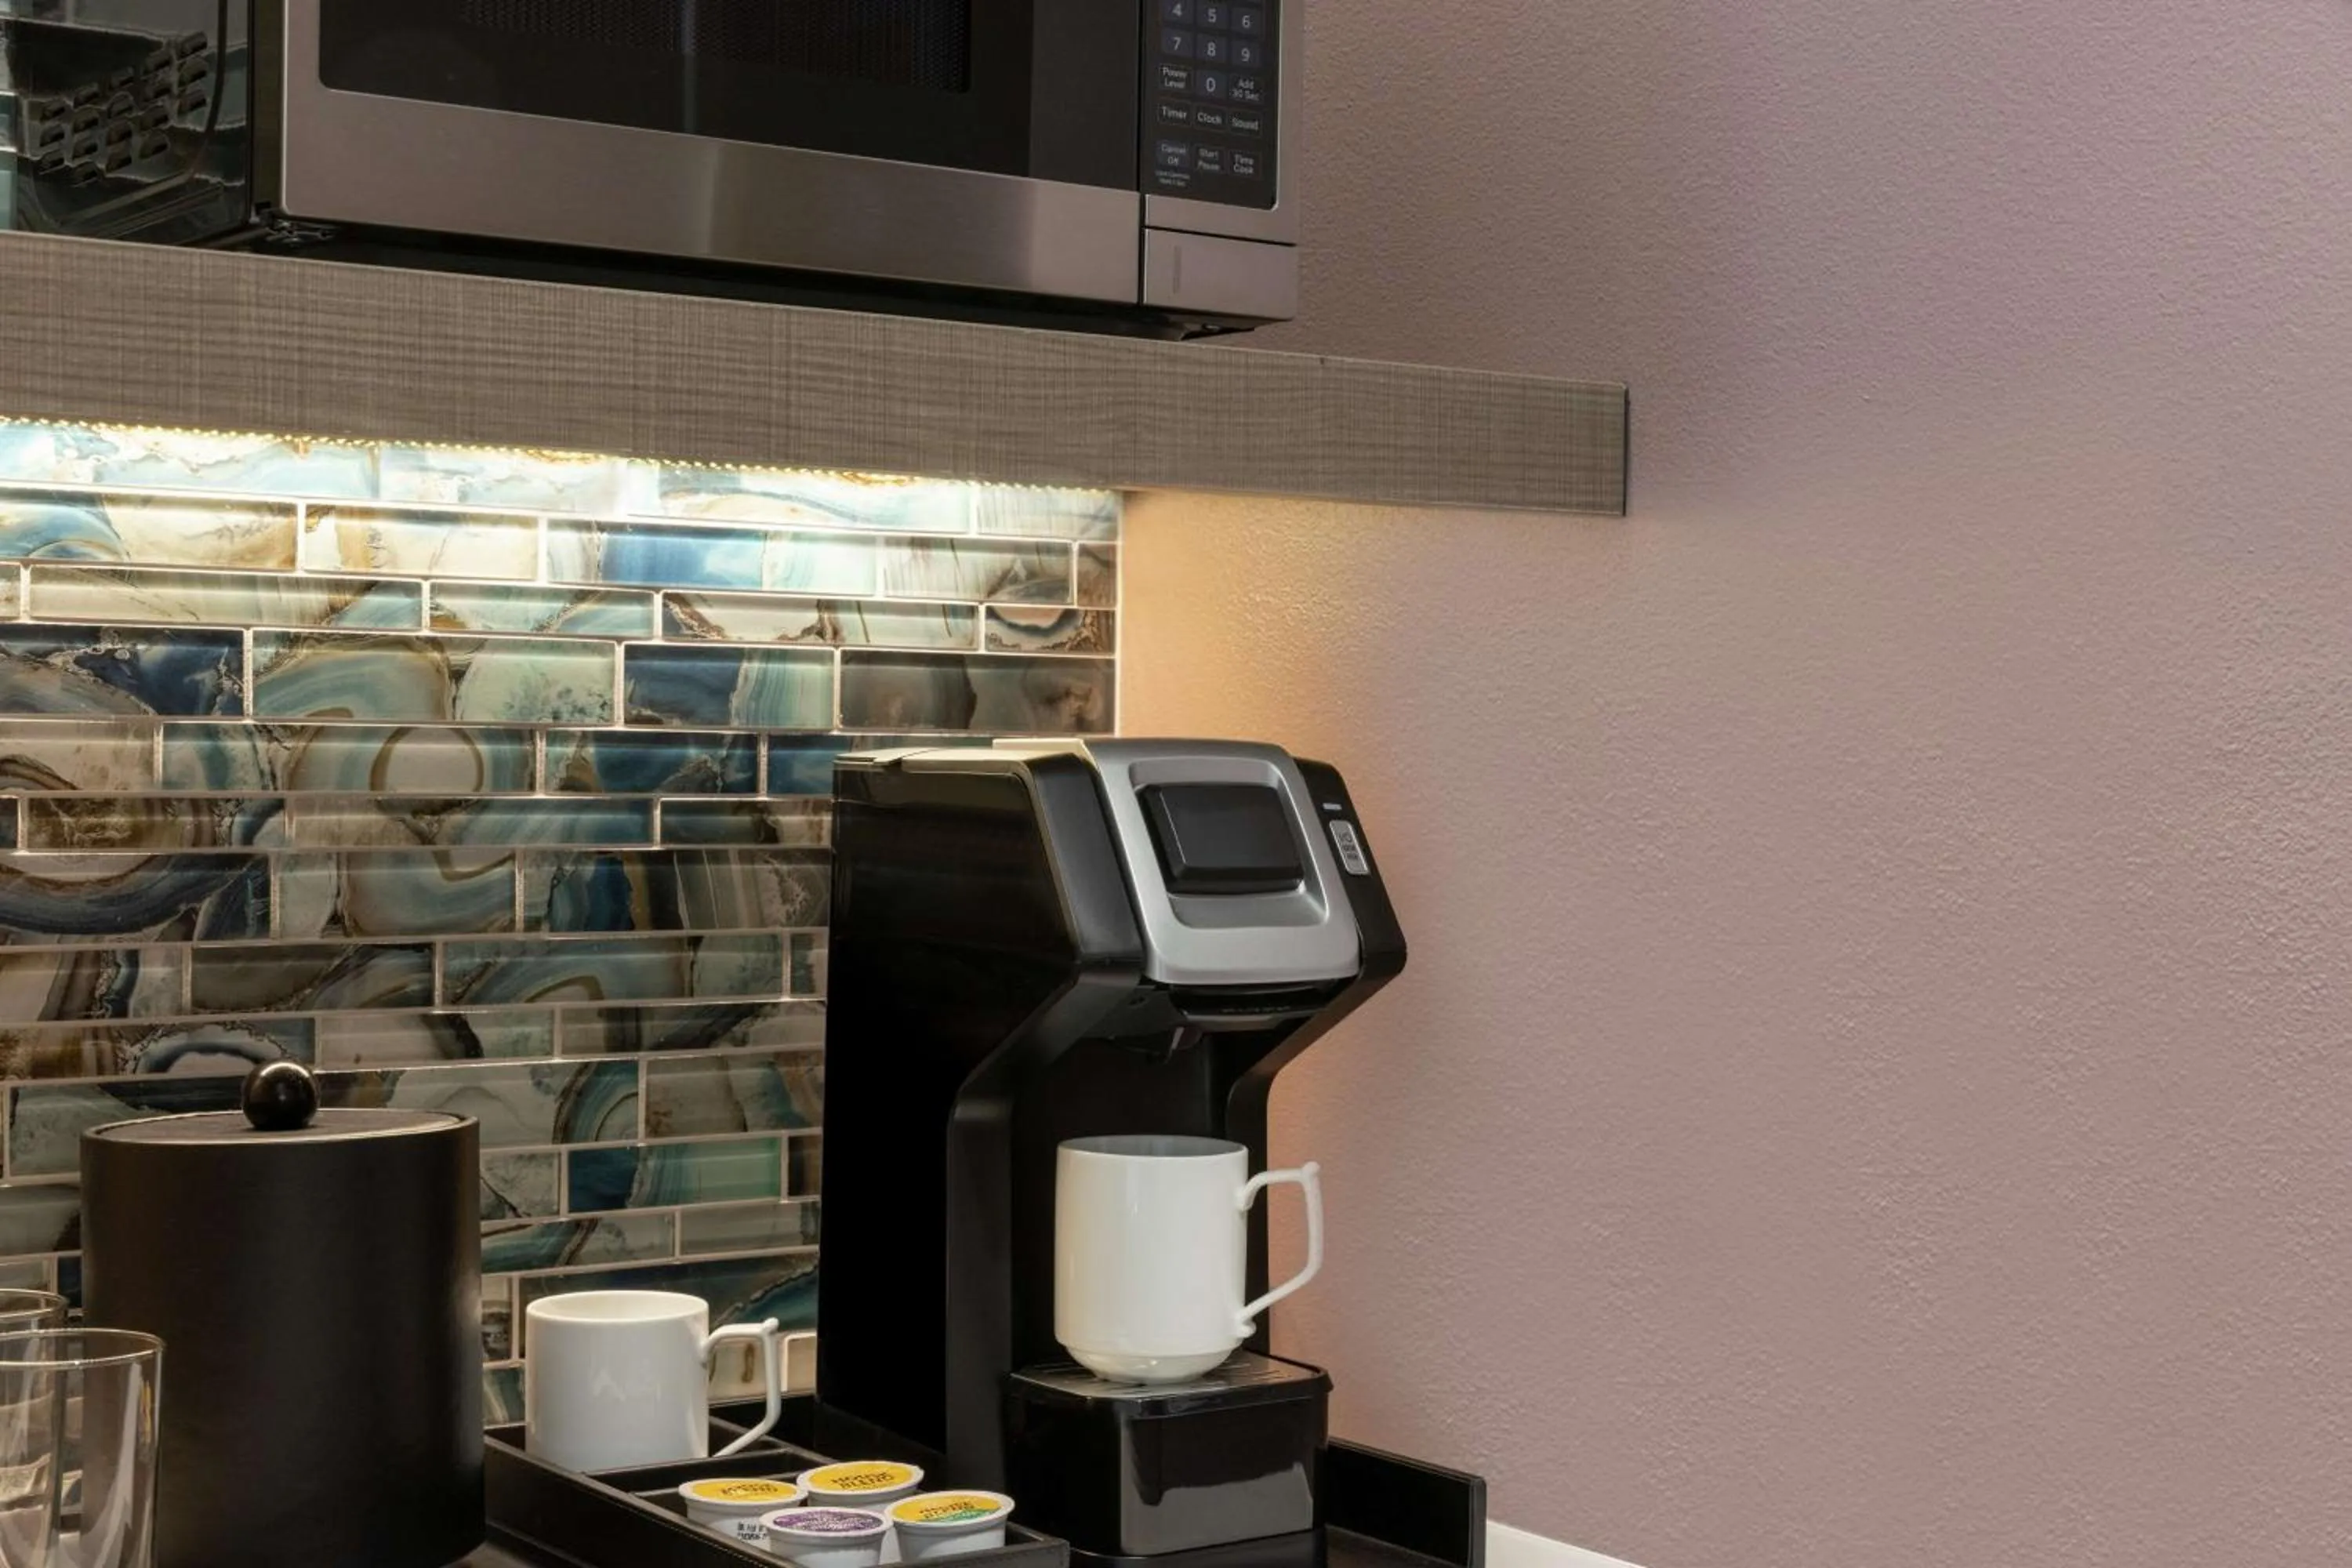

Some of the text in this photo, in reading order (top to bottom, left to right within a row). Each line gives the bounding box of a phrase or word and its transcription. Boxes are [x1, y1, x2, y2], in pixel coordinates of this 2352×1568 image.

[1172, 3, 1182, 17] 4
[1208, 8, 1217, 23] 5
[1242, 15, 1250, 28] 6
[1173, 37, 1181, 50] 7
[1207, 42, 1216, 56] 8
[1241, 48, 1250, 62] 9
[1206, 77, 1215, 92] 0
[1162, 106, 1187, 119] Timer
[1197, 112, 1221, 125] Clock
[1232, 117, 1258, 130] Sound
